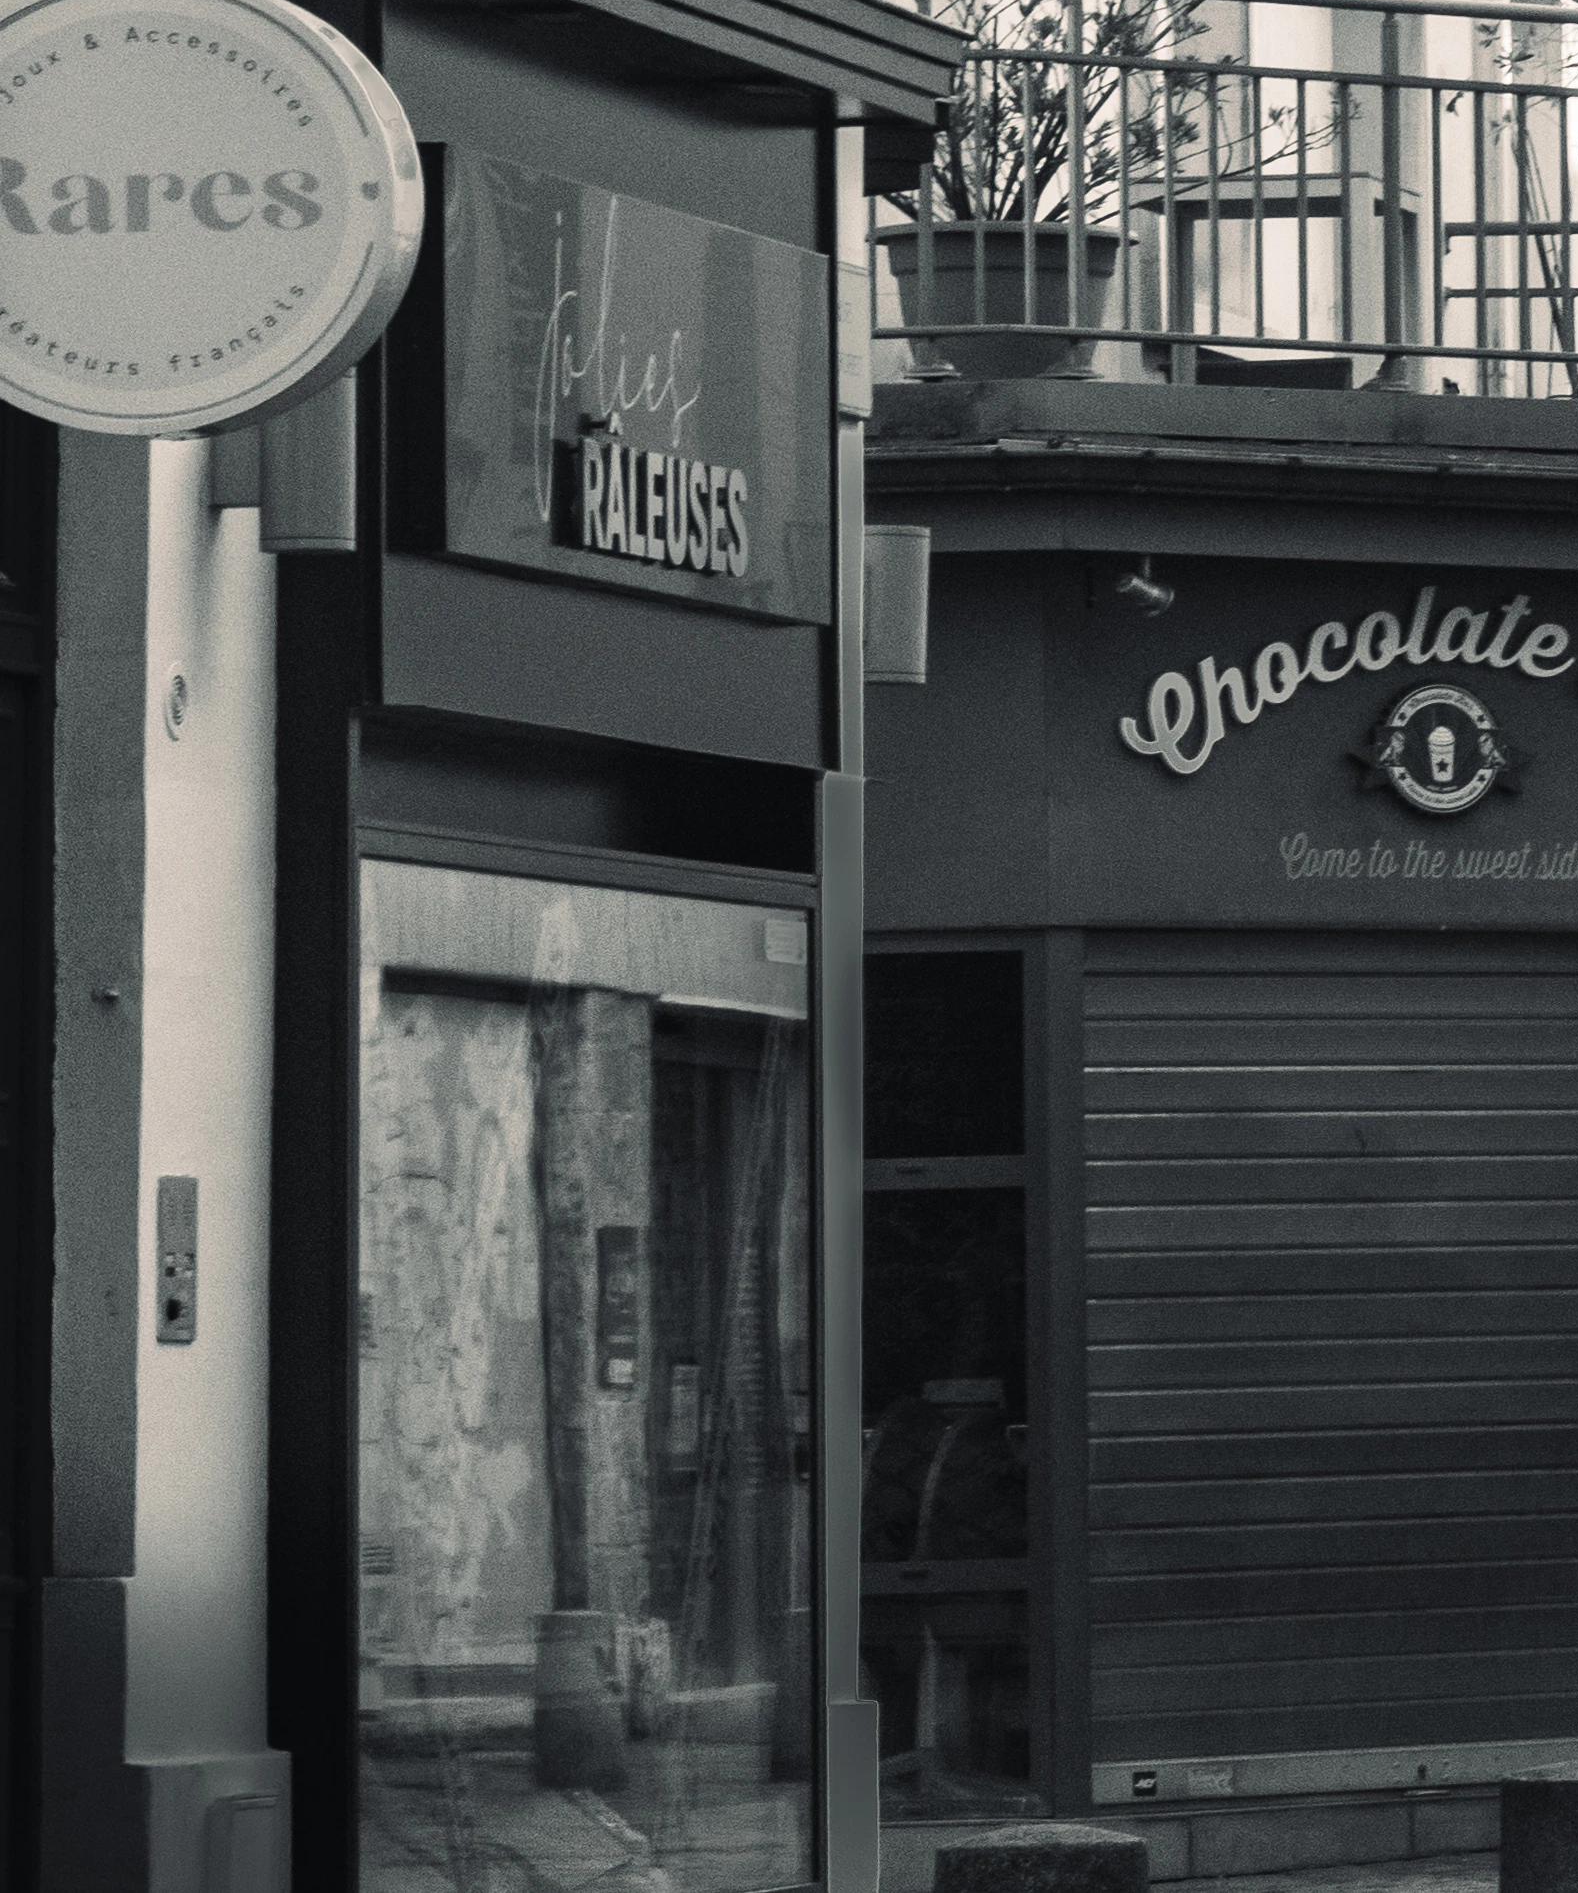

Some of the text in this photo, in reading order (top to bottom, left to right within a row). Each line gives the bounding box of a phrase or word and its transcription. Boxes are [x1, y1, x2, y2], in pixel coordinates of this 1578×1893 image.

[581, 412, 749, 578] RÂLEUSES
[1120, 585, 1575, 774] Chocolate
[1279, 832, 1362, 879] Come
[1367, 839, 1399, 878] to
[1402, 839, 1448, 879] the
[1451, 842, 1532, 880] sweet
